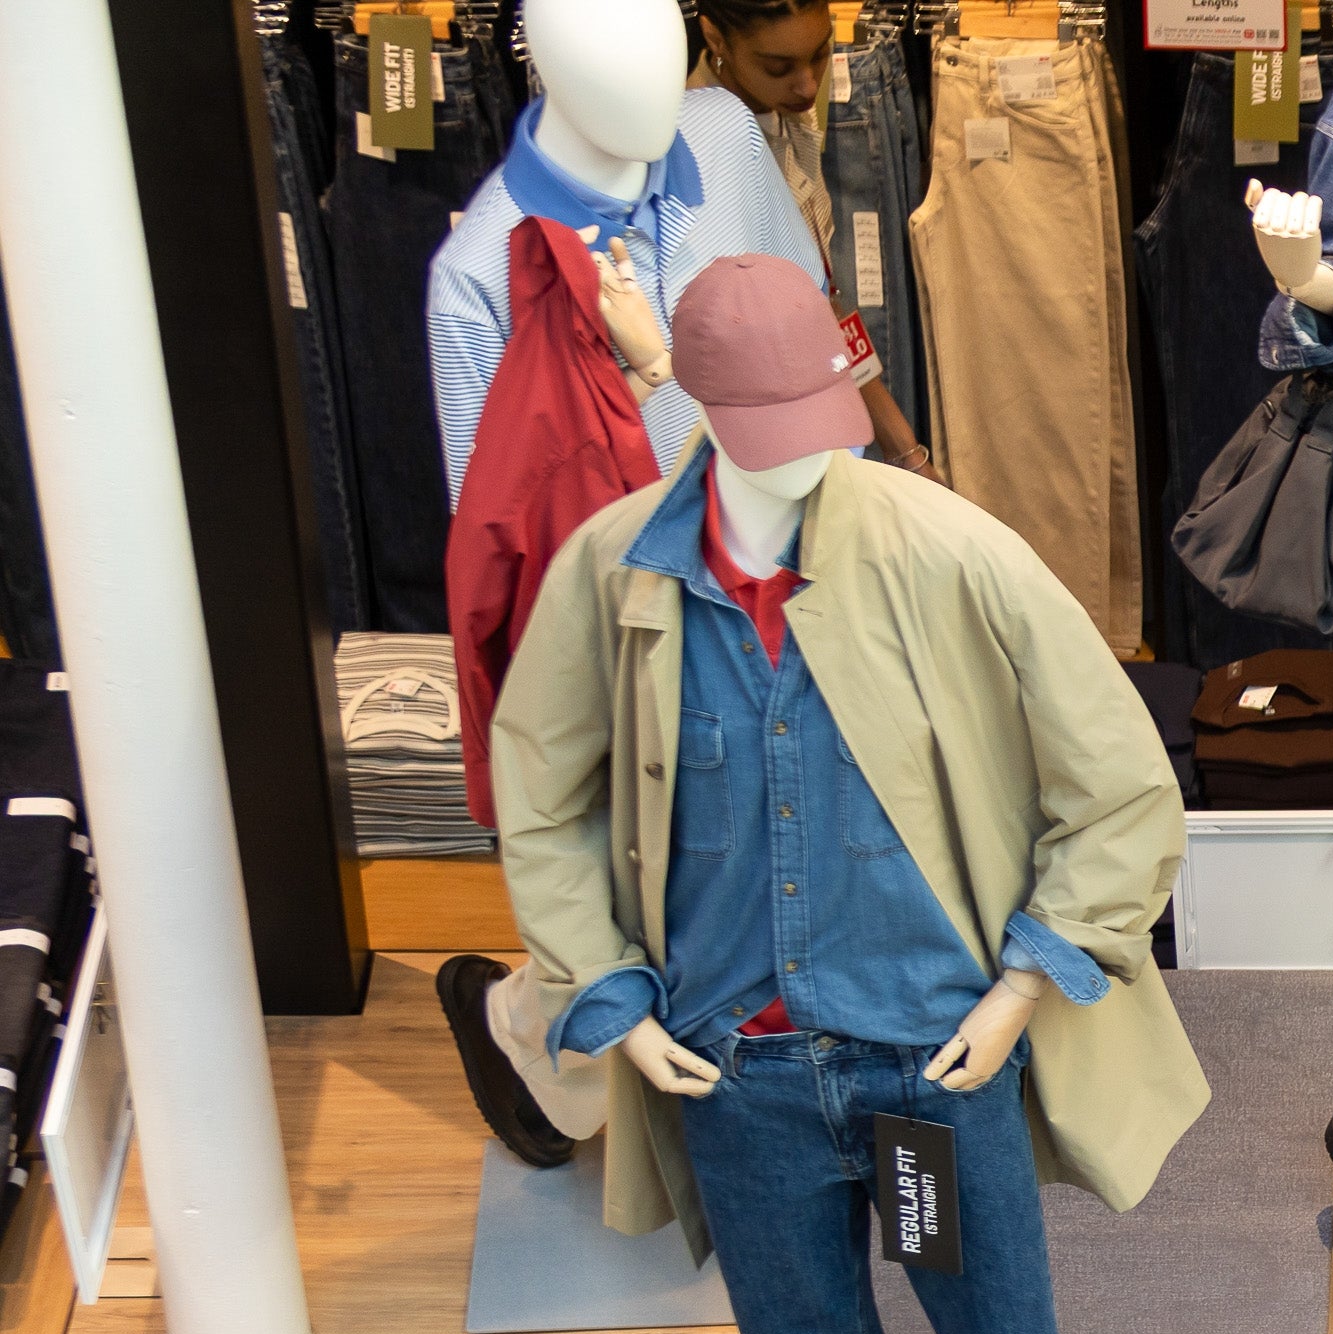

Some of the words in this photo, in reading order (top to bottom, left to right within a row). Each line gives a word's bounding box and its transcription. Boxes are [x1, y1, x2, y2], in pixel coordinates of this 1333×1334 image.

[383, 42, 401, 70] FIT
[1271, 51, 1284, 102] (STRAIGH
[383, 70, 402, 113] WIDE
[1251, 62, 1268, 106] WIDE
[895, 1145, 917, 1174] FIT
[897, 1175, 922, 1254] REGULAR
[921, 1173, 939, 1235] (STRAIGHT)
